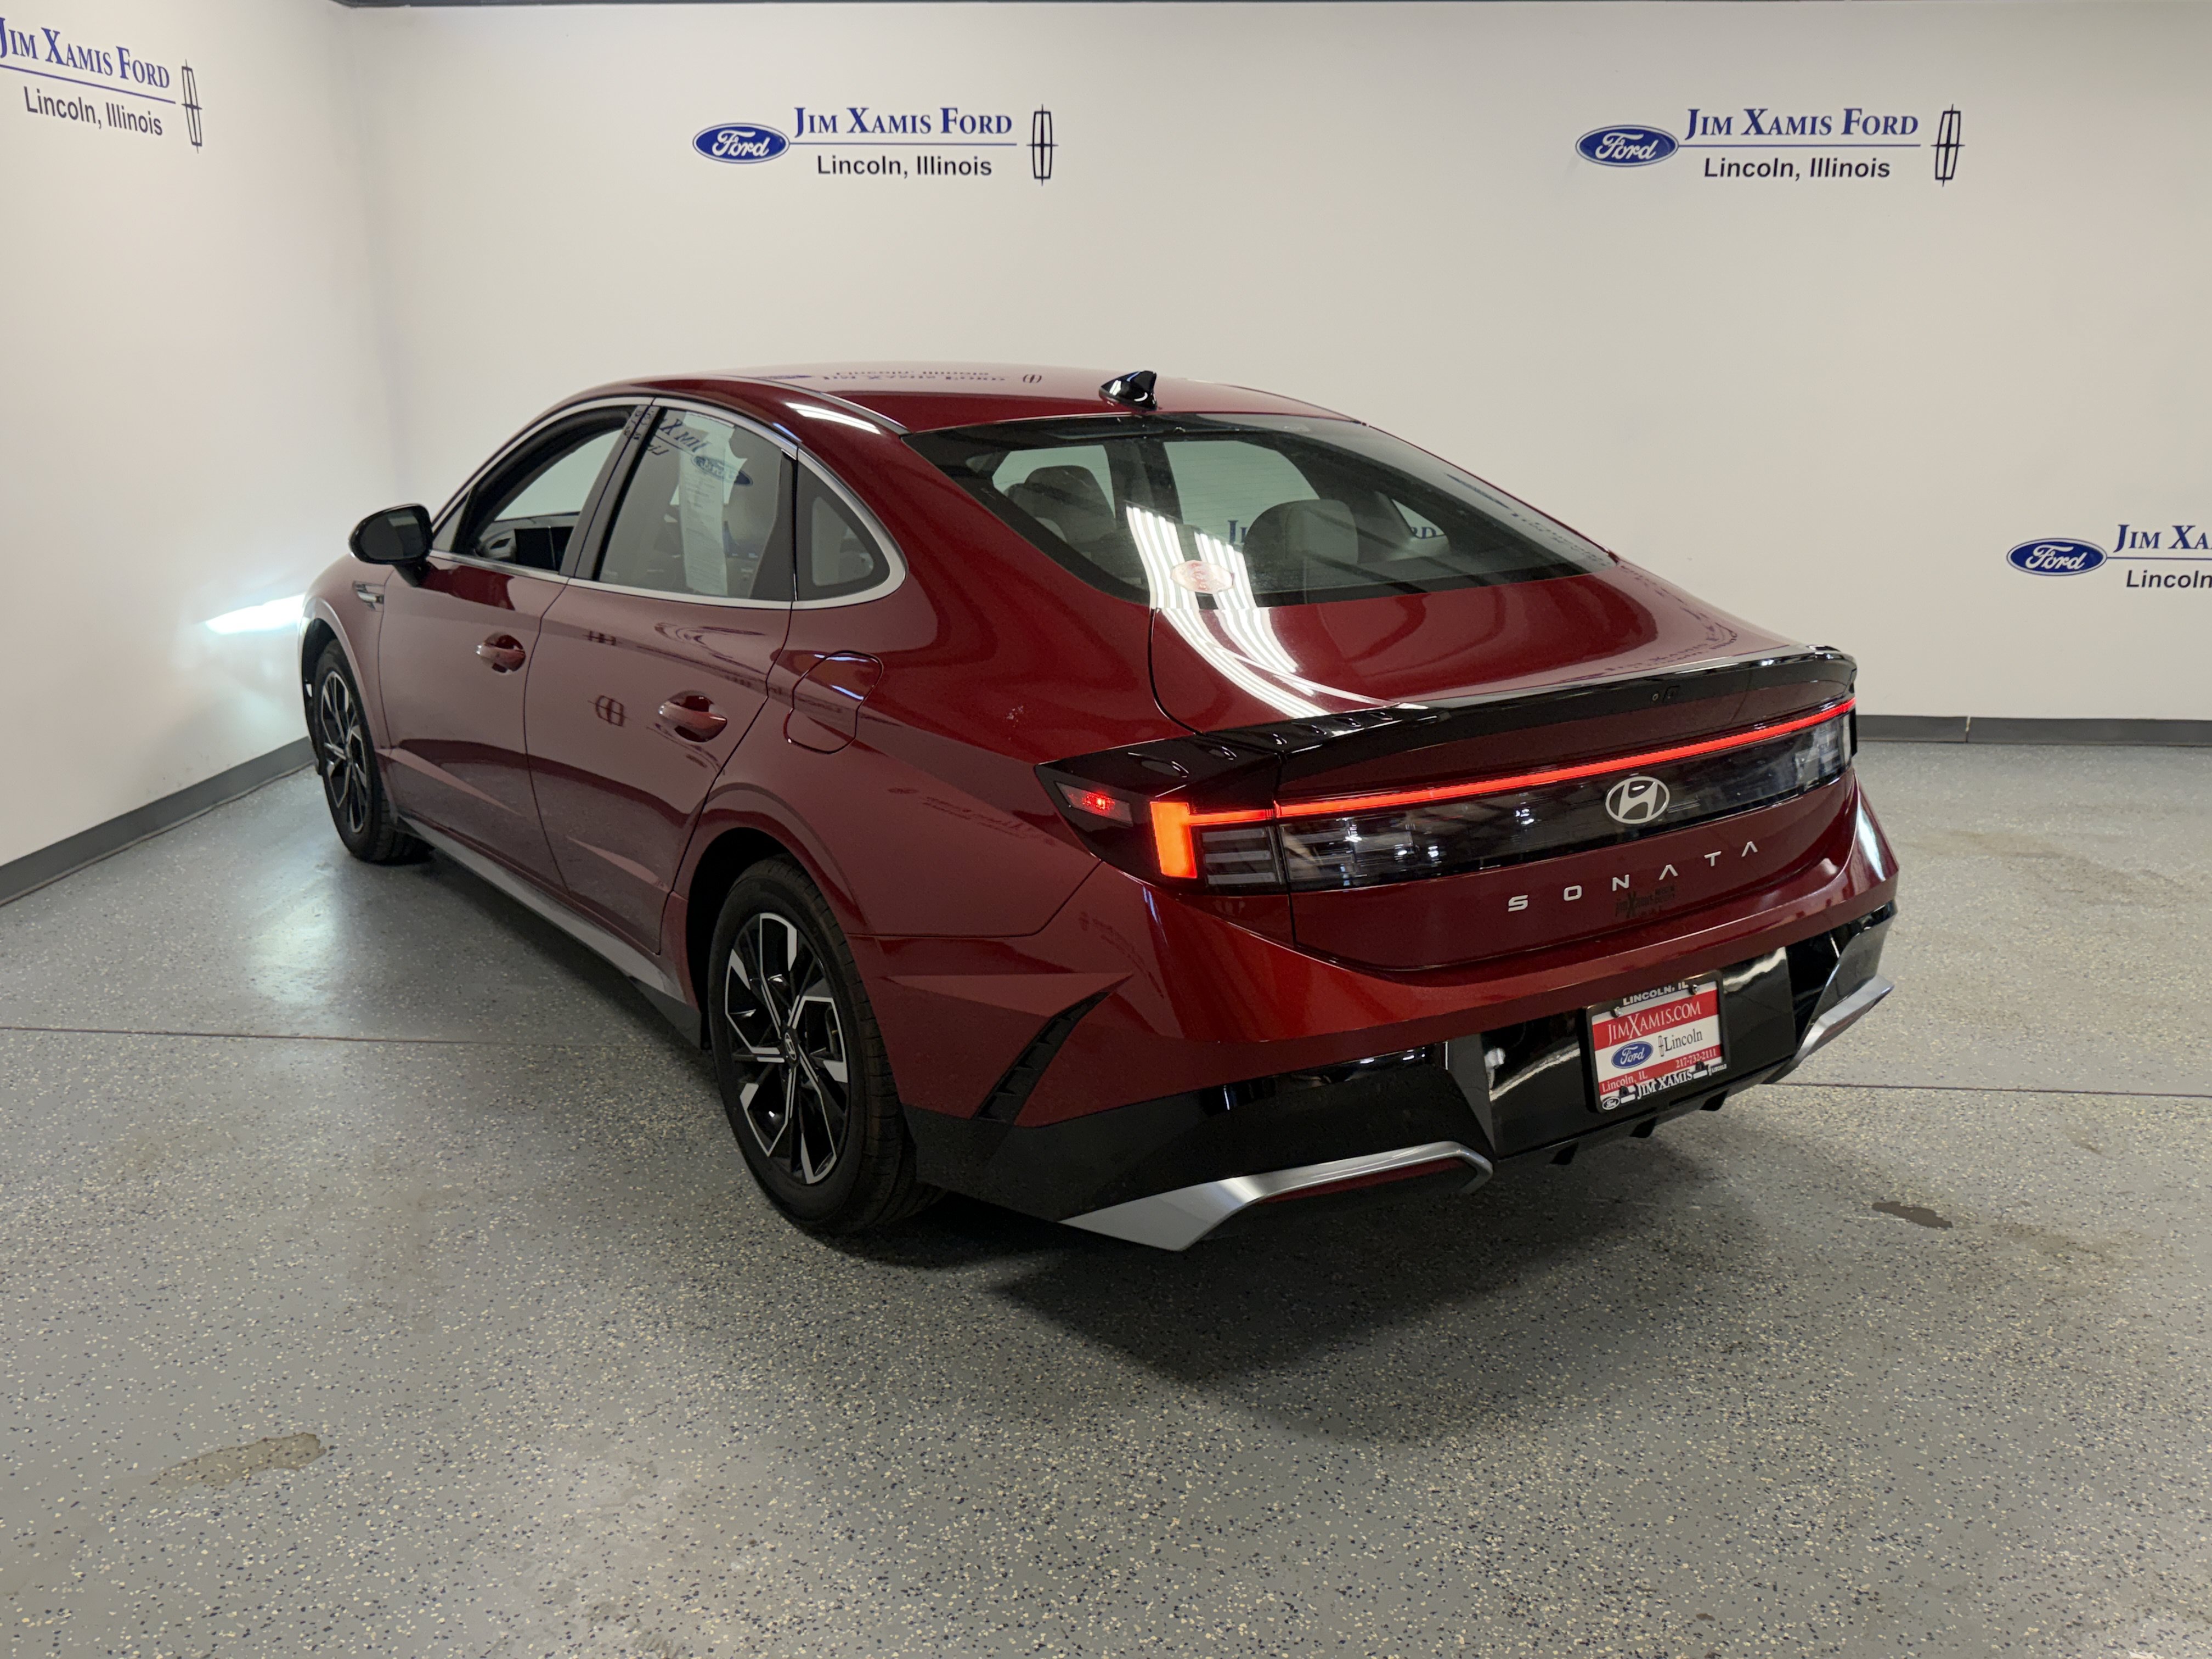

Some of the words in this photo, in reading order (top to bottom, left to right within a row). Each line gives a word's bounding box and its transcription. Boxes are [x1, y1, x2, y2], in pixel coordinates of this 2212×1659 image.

[41, 27, 113, 76] XAMIS
[116, 46, 170, 88] FORD
[24, 86, 102, 129] Lincoln,
[106, 102, 163, 136] Illinois
[794, 108, 838, 138] JIM
[847, 108, 932, 134] XAMIS
[940, 108, 1012, 134] FORD
[1684, 109, 1733, 140] JIM
[1741, 109, 1832, 135] XAMIS
[1841, 108, 1918, 136] FORD
[712, 130, 771, 157] Ford
[1595, 133, 1659, 159] Ford
[817, 155, 908, 179] Lincoln,
[917, 156, 992, 176] Illinois
[1705, 158, 1800, 181] Lincoln,
[1810, 158, 1891, 178] Illinois
[2113, 524, 2162, 553] JIM
[2168, 525, 2212, 550] XA
[2025, 544, 2087, 571] Ford
[1508, 841, 1758, 912] SONATA
[1678, 981, 1689, 990] IL
[1608, 1001, 1702, 1046] JIMXAMIS.COM
[1663, 1028, 1703, 1052] Lincoln
[1620, 1046, 1645, 1064] Ford
[1675, 1048, 1717, 1069] 217-732-2111
[1602, 1075, 1637, 1092] Lincoln,
[1639, 1070, 1648, 1080] IL
[1637, 1081, 1657, 1100] JIM
[1657, 1070, 1693, 1091] XAMIS
